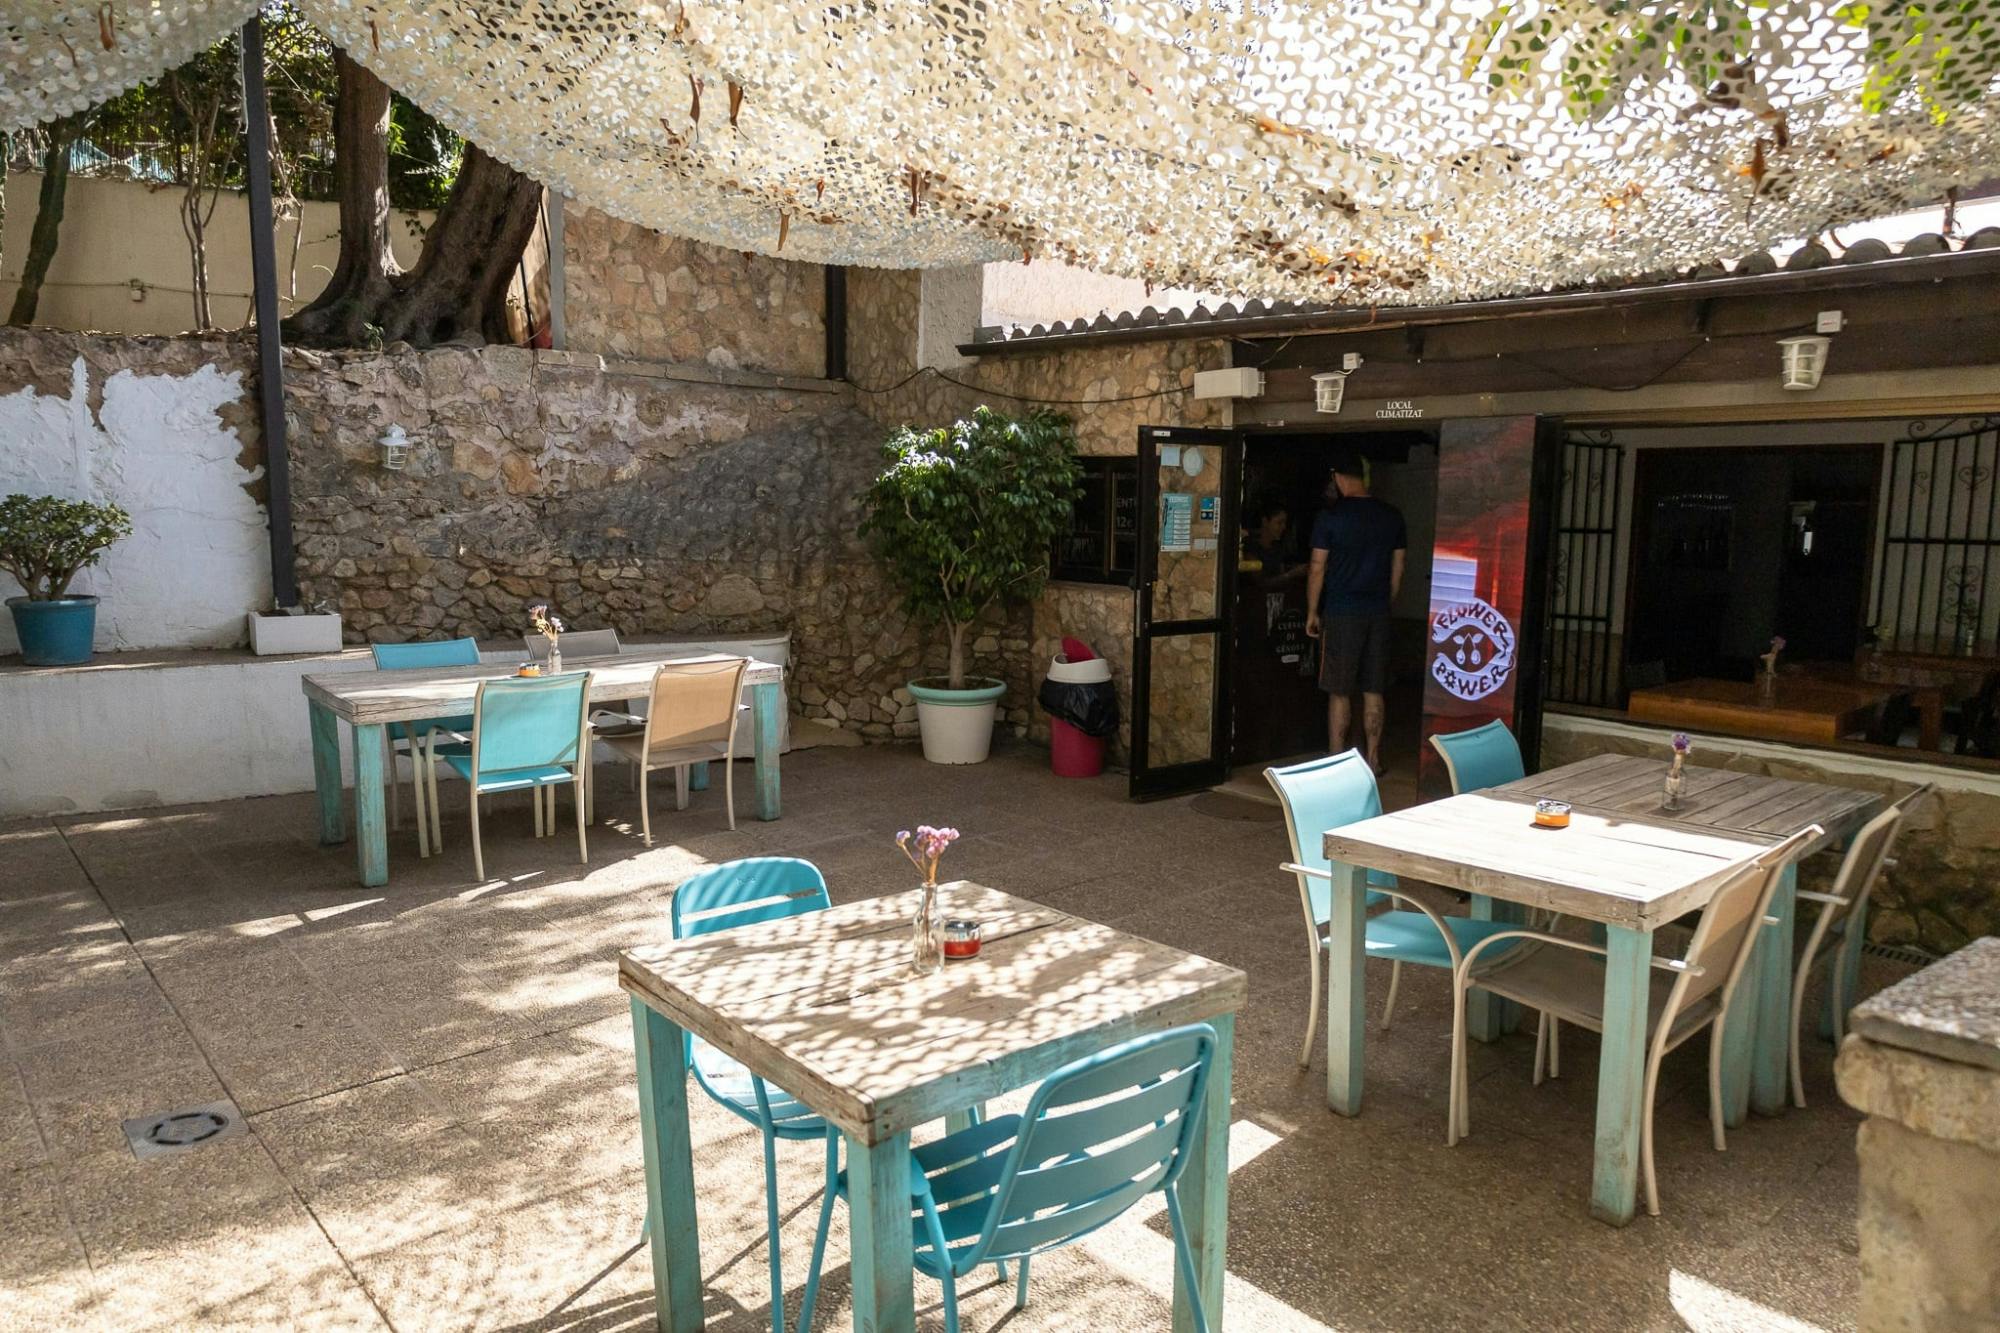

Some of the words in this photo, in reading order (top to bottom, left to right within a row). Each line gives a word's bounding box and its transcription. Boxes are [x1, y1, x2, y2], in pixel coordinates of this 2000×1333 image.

[1375, 409, 1424, 419] CLIMATIZAT
[1387, 400, 1413, 410] LOCAL
[1437, 602, 1510, 648] FLOWER
[1436, 662, 1513, 696] POWER
